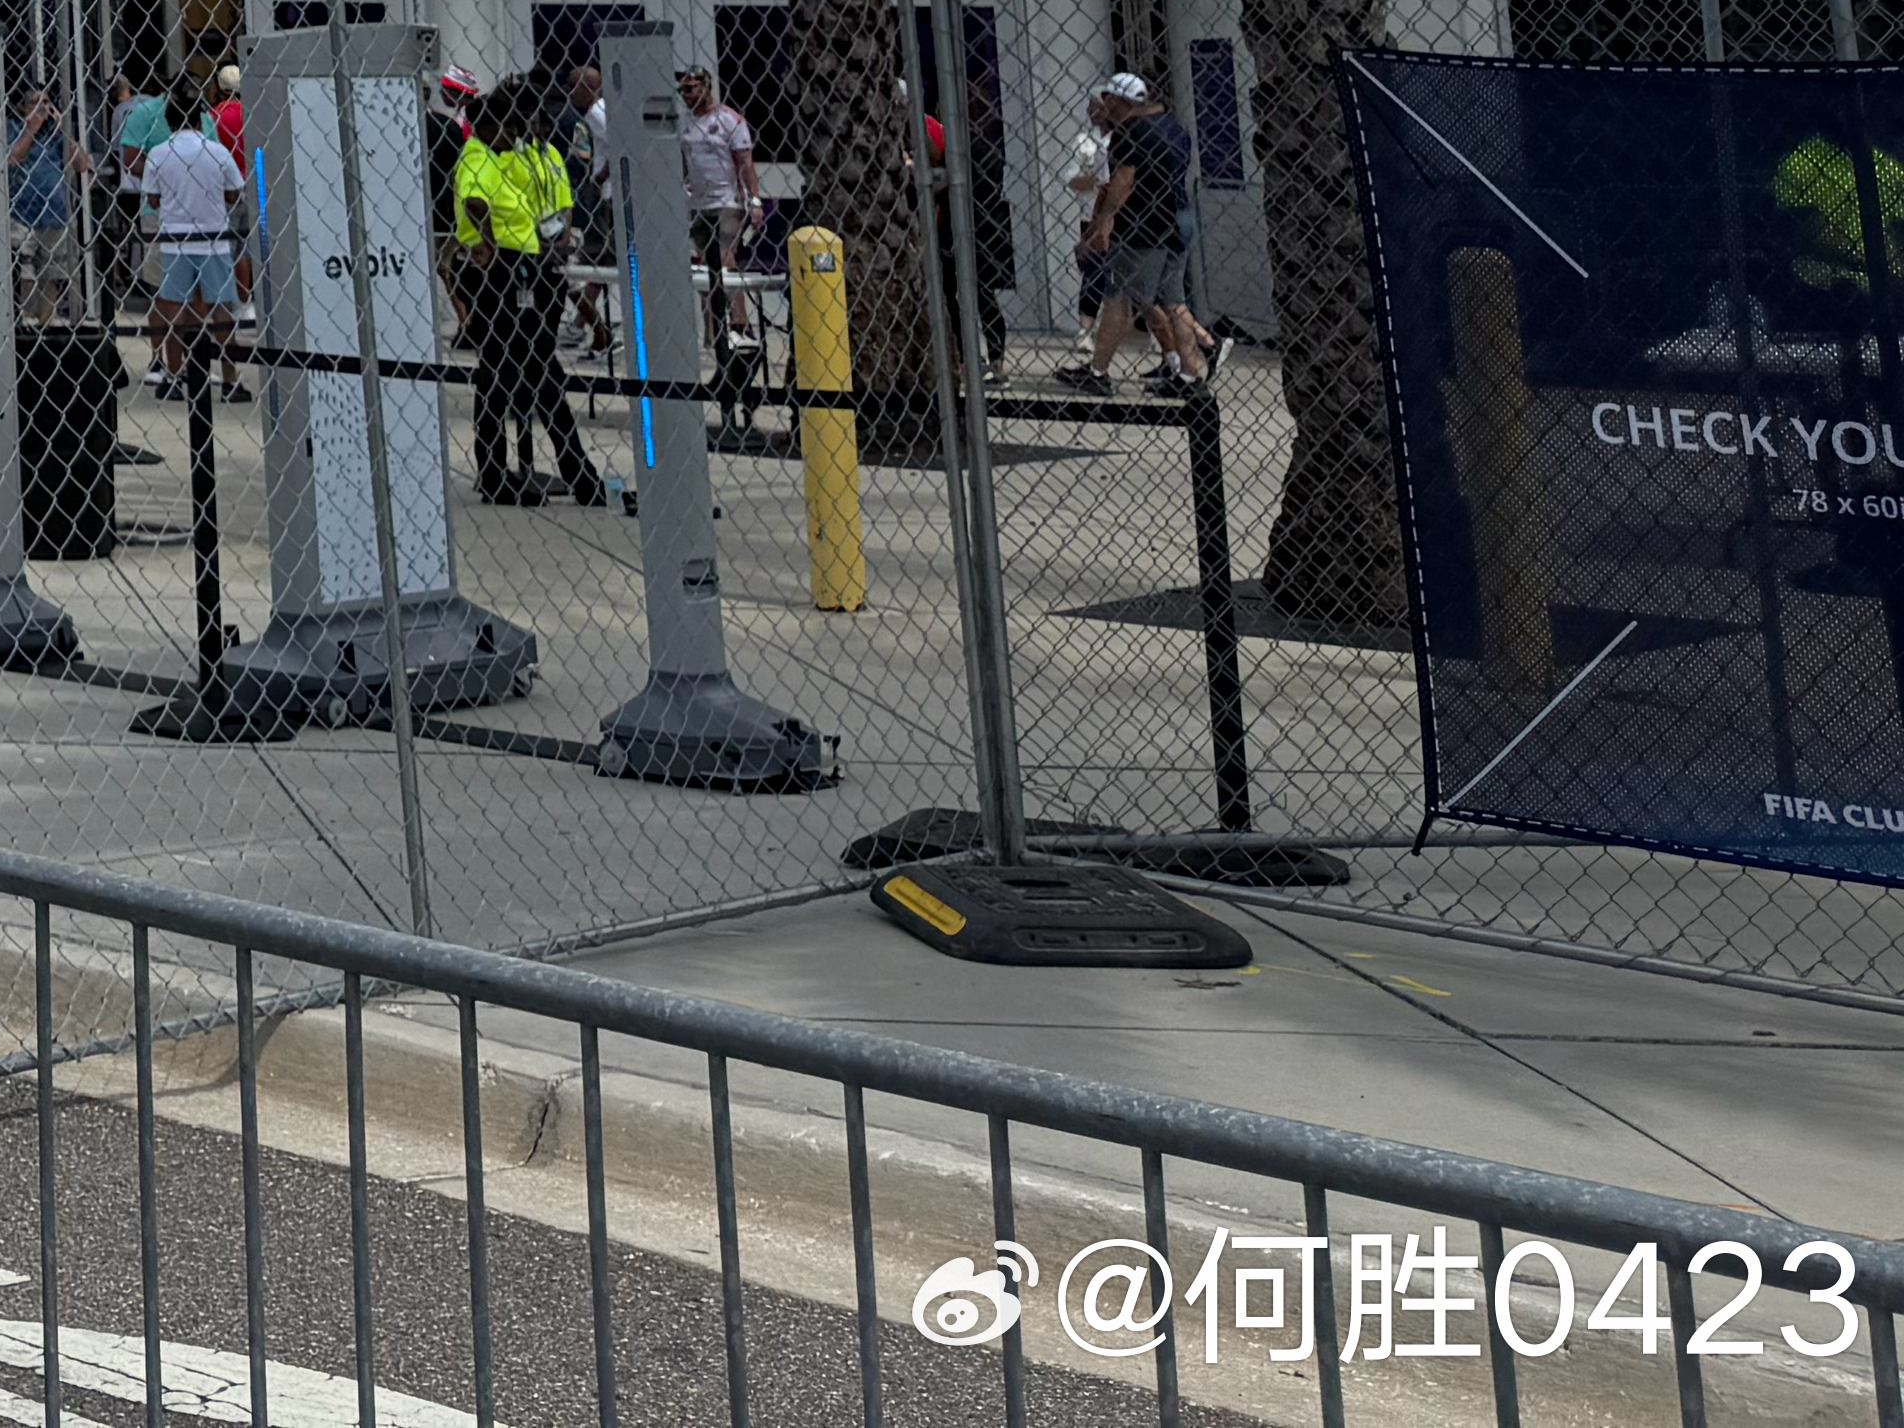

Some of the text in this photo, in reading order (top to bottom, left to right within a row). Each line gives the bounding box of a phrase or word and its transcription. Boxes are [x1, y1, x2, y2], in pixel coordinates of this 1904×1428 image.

[1592, 402, 1778, 457] CHECK
[1793, 489, 1828, 512] 78
[1837, 496, 1856, 515] x
[1764, 793, 1904, 832] FIFA CLU
